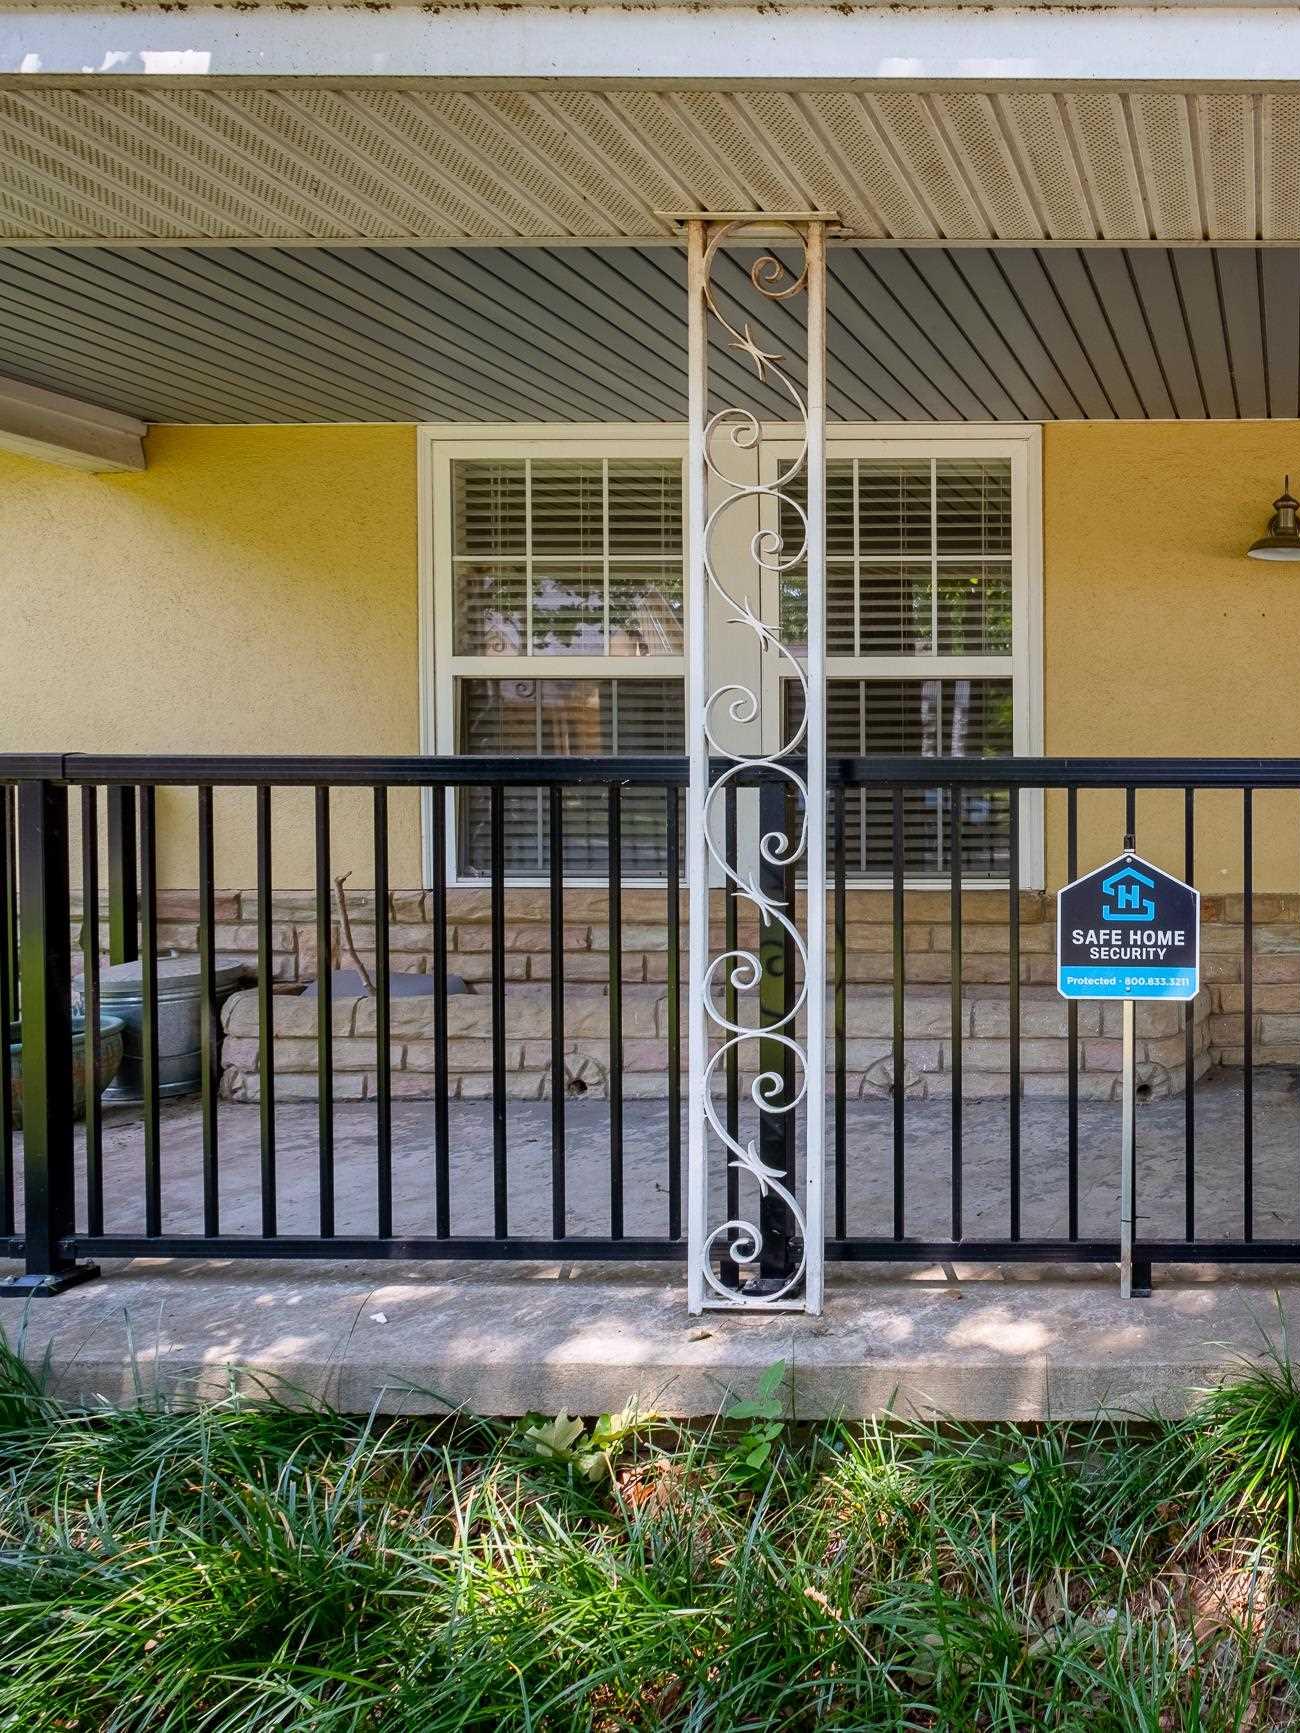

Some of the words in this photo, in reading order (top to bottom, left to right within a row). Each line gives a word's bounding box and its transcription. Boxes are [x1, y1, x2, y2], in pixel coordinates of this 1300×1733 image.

[1071, 929, 1122, 945] SAFE
[1129, 930, 1185, 946] HOME
[1089, 947, 1167, 960] SECURITY
[1066, 976, 1117, 986] Protected
